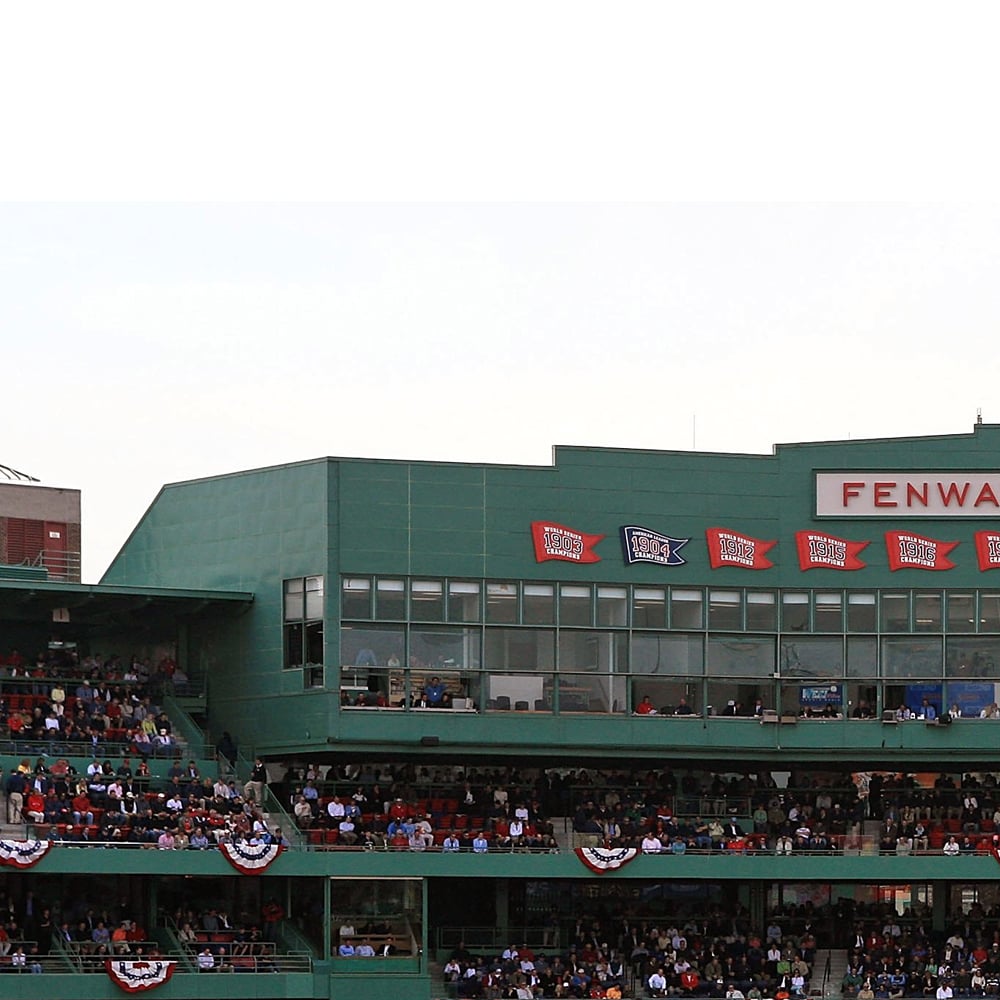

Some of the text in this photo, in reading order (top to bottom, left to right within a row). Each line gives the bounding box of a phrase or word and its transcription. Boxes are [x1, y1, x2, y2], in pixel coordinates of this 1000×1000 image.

[544, 533, 583, 554] 1903
[632, 536, 670, 557] 1904
[720, 539, 754, 560] 1912
[809, 540, 846, 560] 1915
[899, 541, 935, 561] 1916
[547, 549, 580, 560] CHAMPIONS
[635, 552, 667, 562] CHAMPIONS
[721, 555, 753, 566] CHAMPIONS
[810, 556, 844, 566] CHAMPIONS
[901, 556, 934, 567] CHAMPIONS
